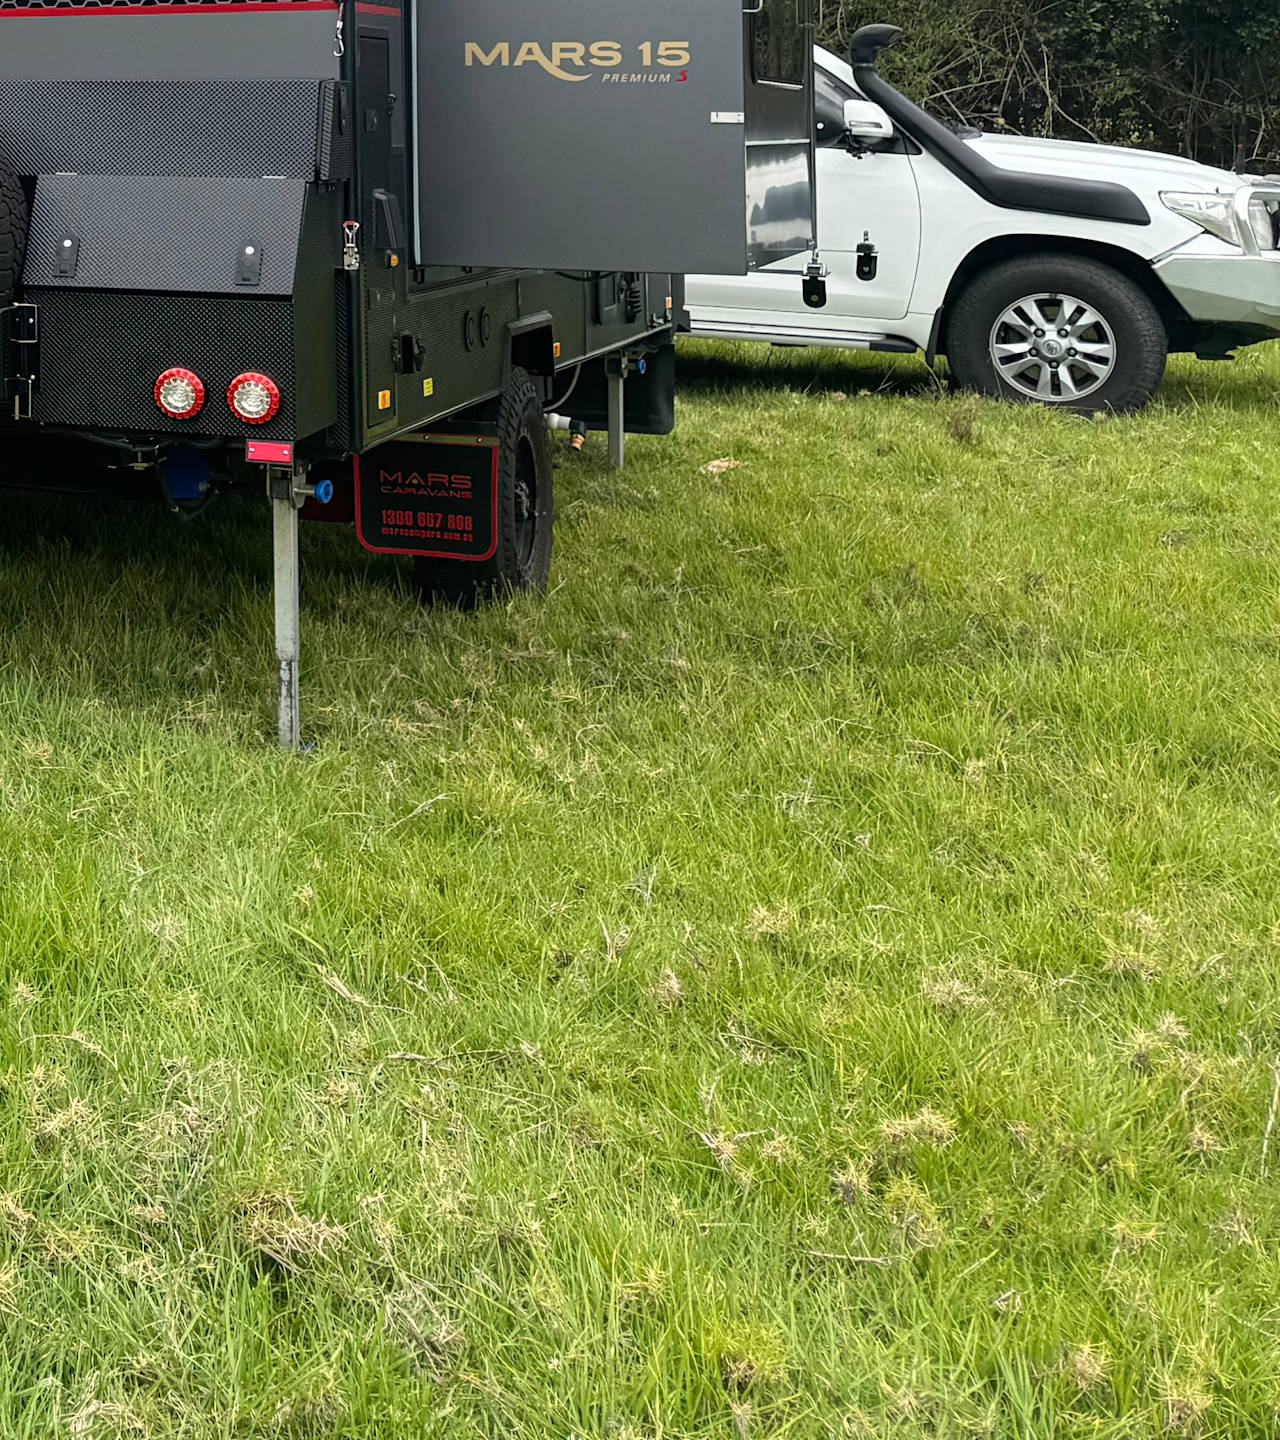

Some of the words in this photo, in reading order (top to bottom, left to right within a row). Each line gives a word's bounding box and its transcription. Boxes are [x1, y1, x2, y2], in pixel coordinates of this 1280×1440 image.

[464, 40, 622, 82] MARS
[638, 41, 691, 67] 15
[601, 73, 671, 83] PREMIUM
[380, 471, 472, 489] MARS
[381, 486, 472, 499] CARAVANS
[382, 510, 413, 527] 1300
